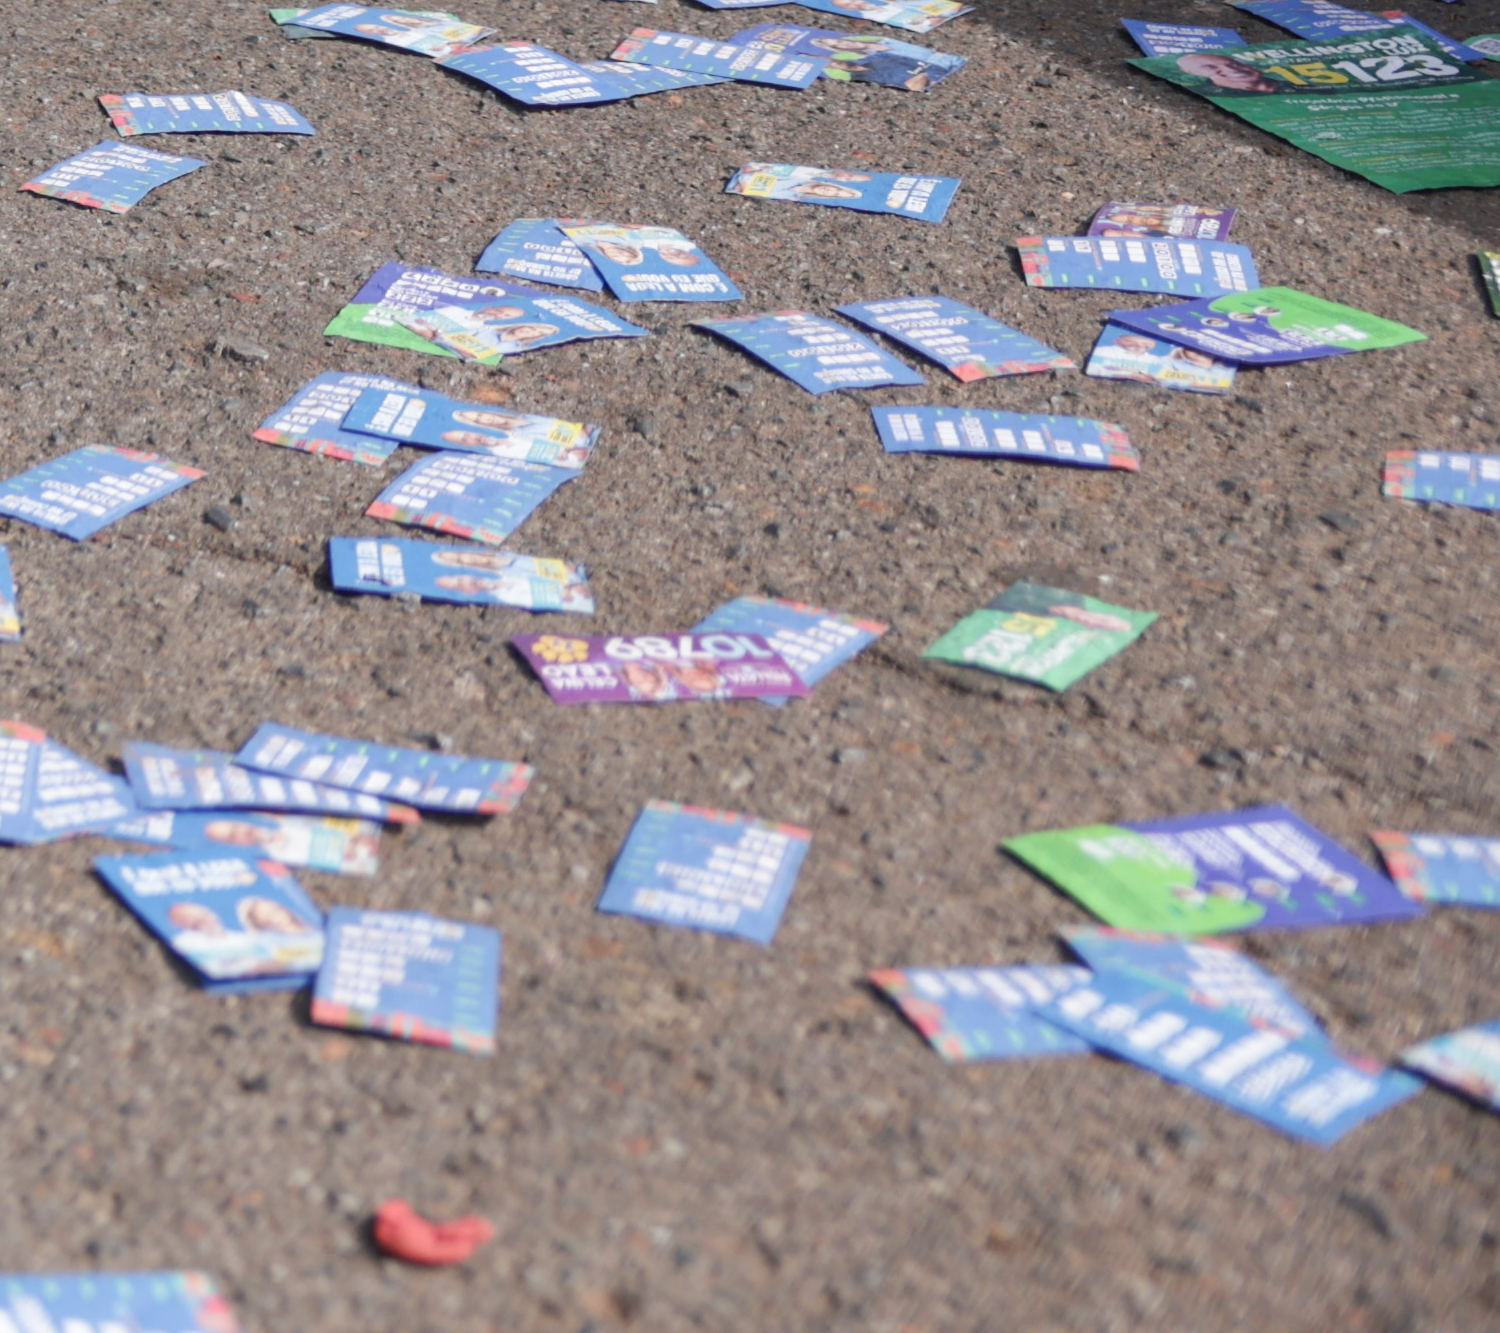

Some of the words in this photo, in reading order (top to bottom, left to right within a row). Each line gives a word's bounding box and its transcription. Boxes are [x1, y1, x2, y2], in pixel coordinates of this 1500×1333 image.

[1232, 35, 1424, 62] WELLINGTON
[1384, 44, 1430, 55] LUIZ
[605, 635, 773, 661] 10789
